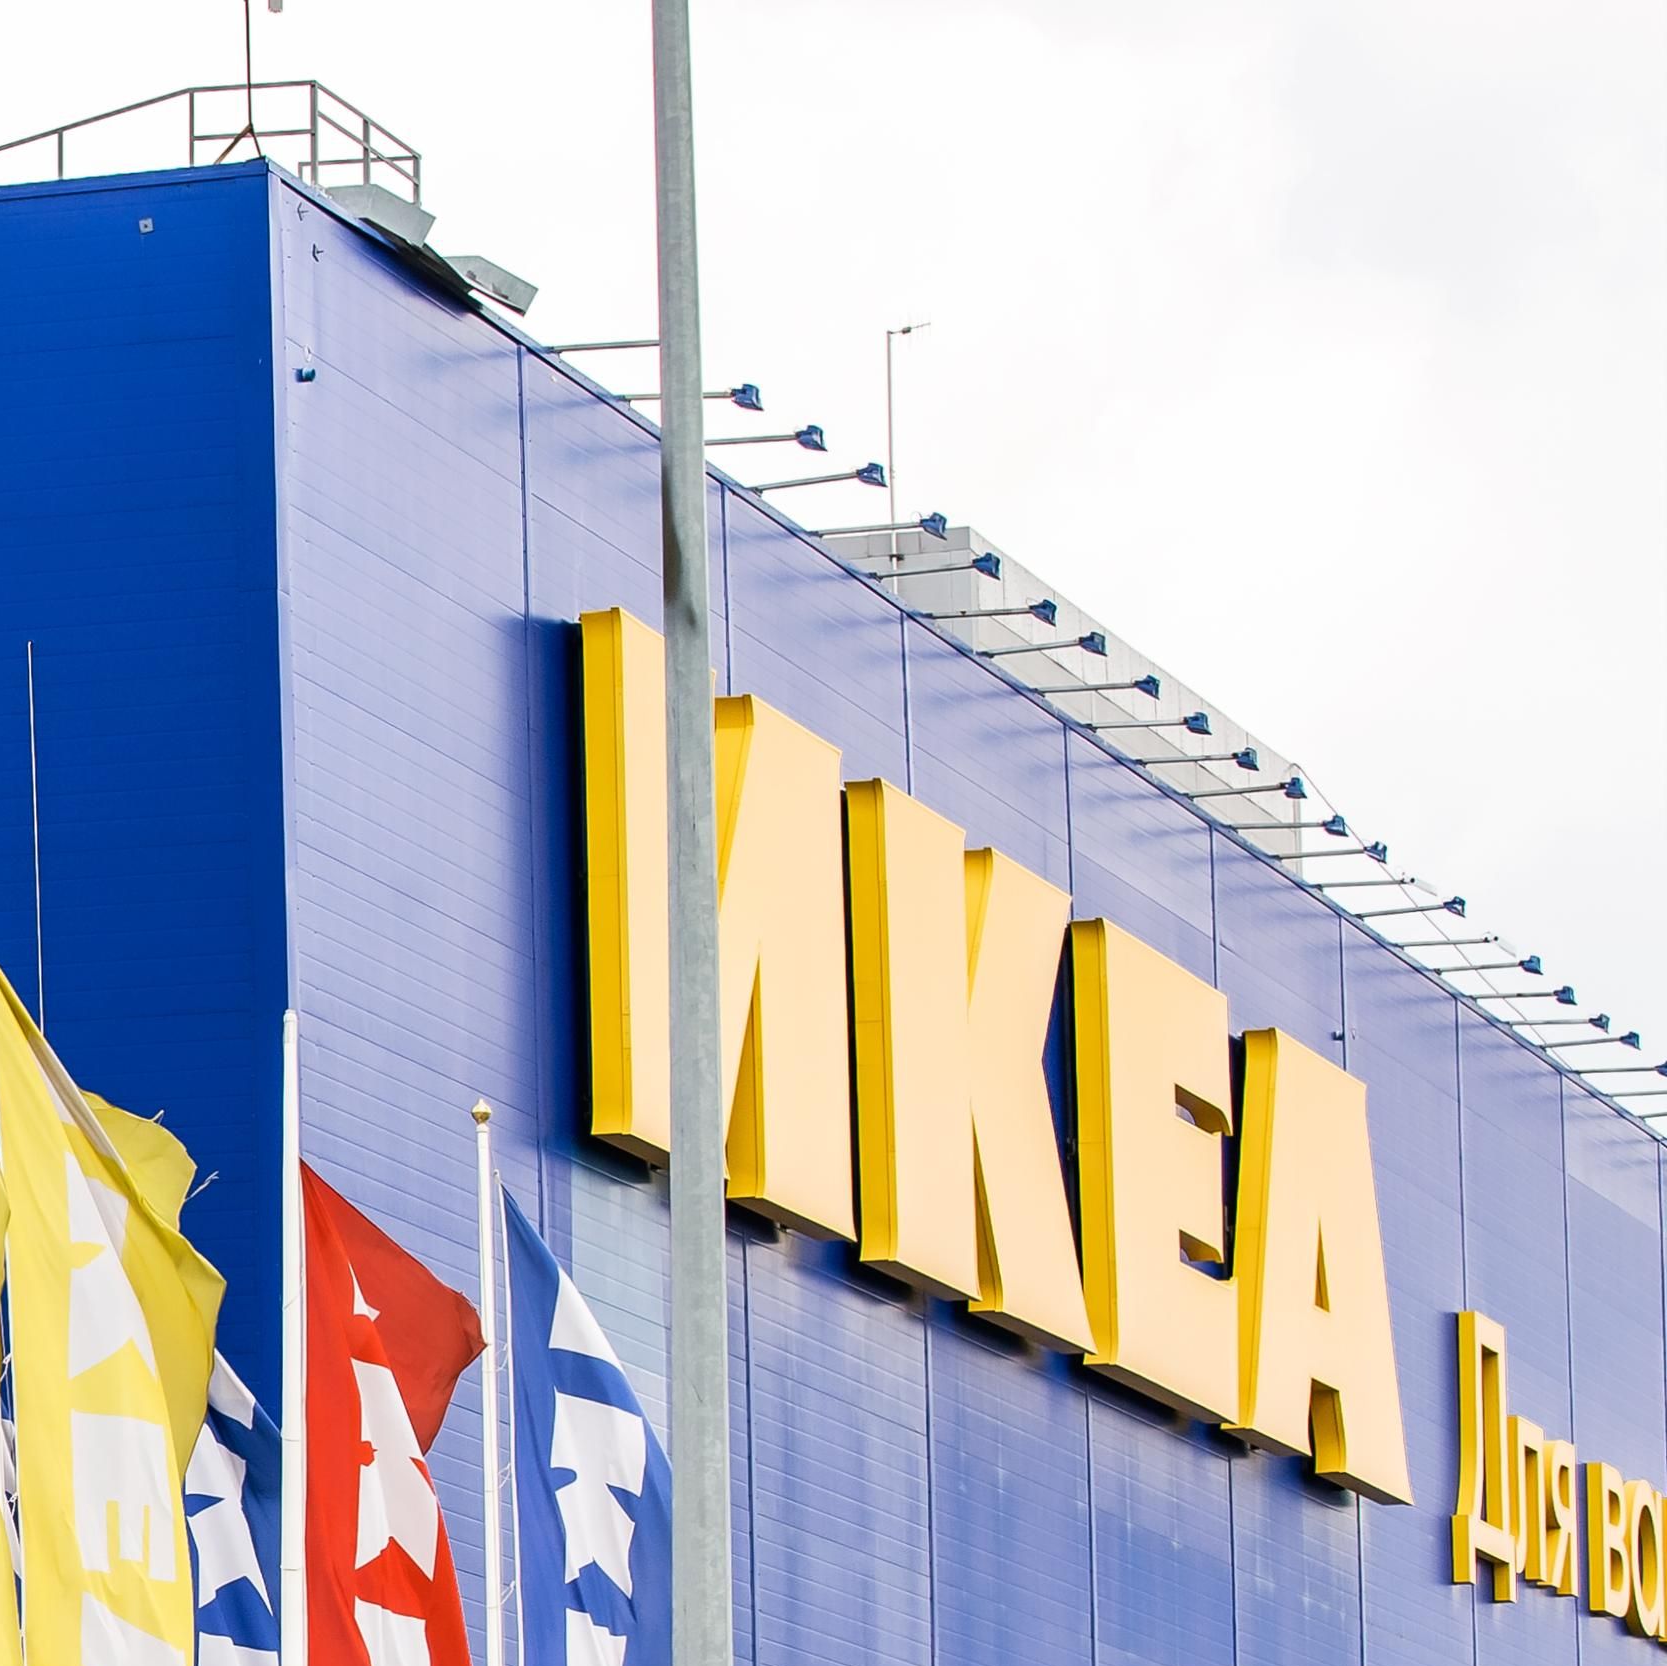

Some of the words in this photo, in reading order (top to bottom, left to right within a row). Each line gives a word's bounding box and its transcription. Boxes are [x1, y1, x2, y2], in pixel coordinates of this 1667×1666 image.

[579, 606, 1415, 1505] ИКЕА
[1451, 1310, 1579, 1604] Для
[1586, 1461, 1667, 1645] во
